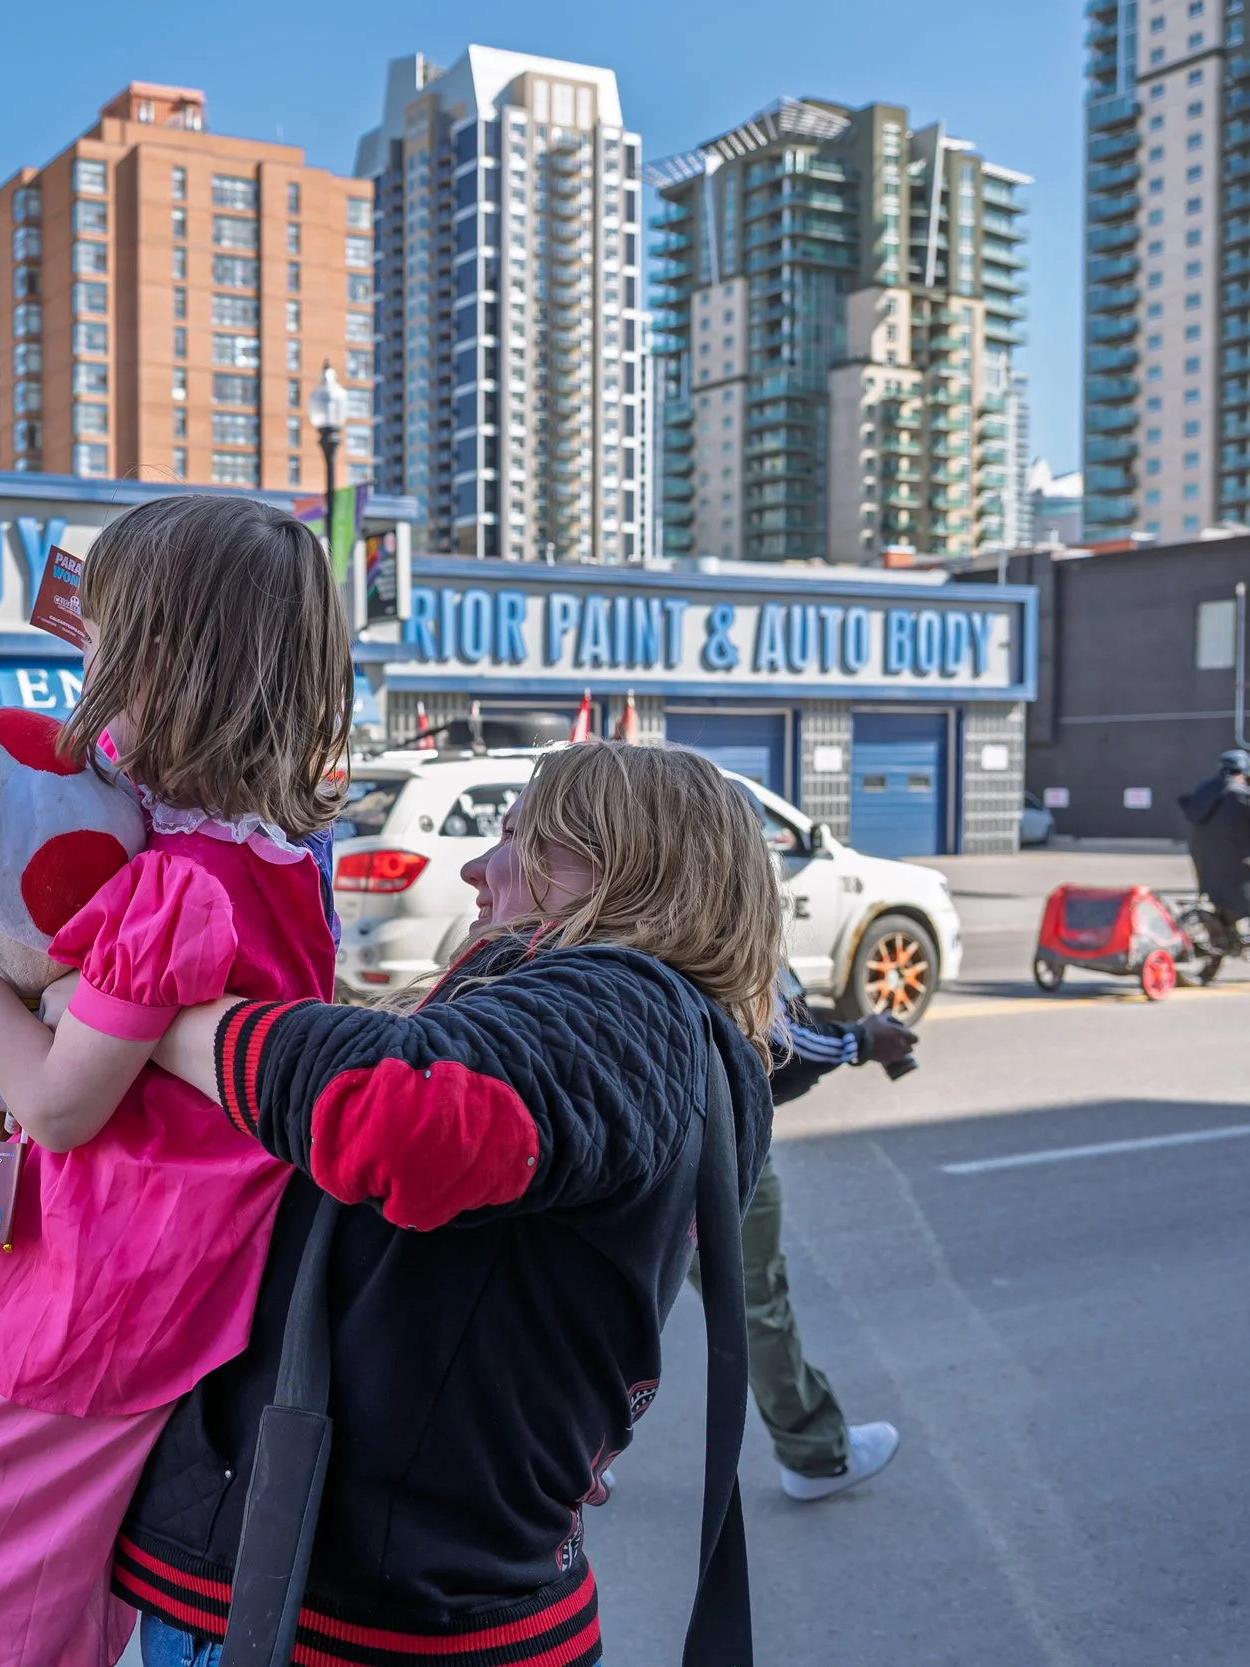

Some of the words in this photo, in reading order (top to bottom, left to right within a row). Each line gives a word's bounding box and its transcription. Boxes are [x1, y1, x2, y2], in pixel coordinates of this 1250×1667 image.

[550, 592, 690, 667] PAINT
[705, 603, 738, 668] &
[756, 603, 870, 670] AUTO
[887, 608, 992, 674] BODY
